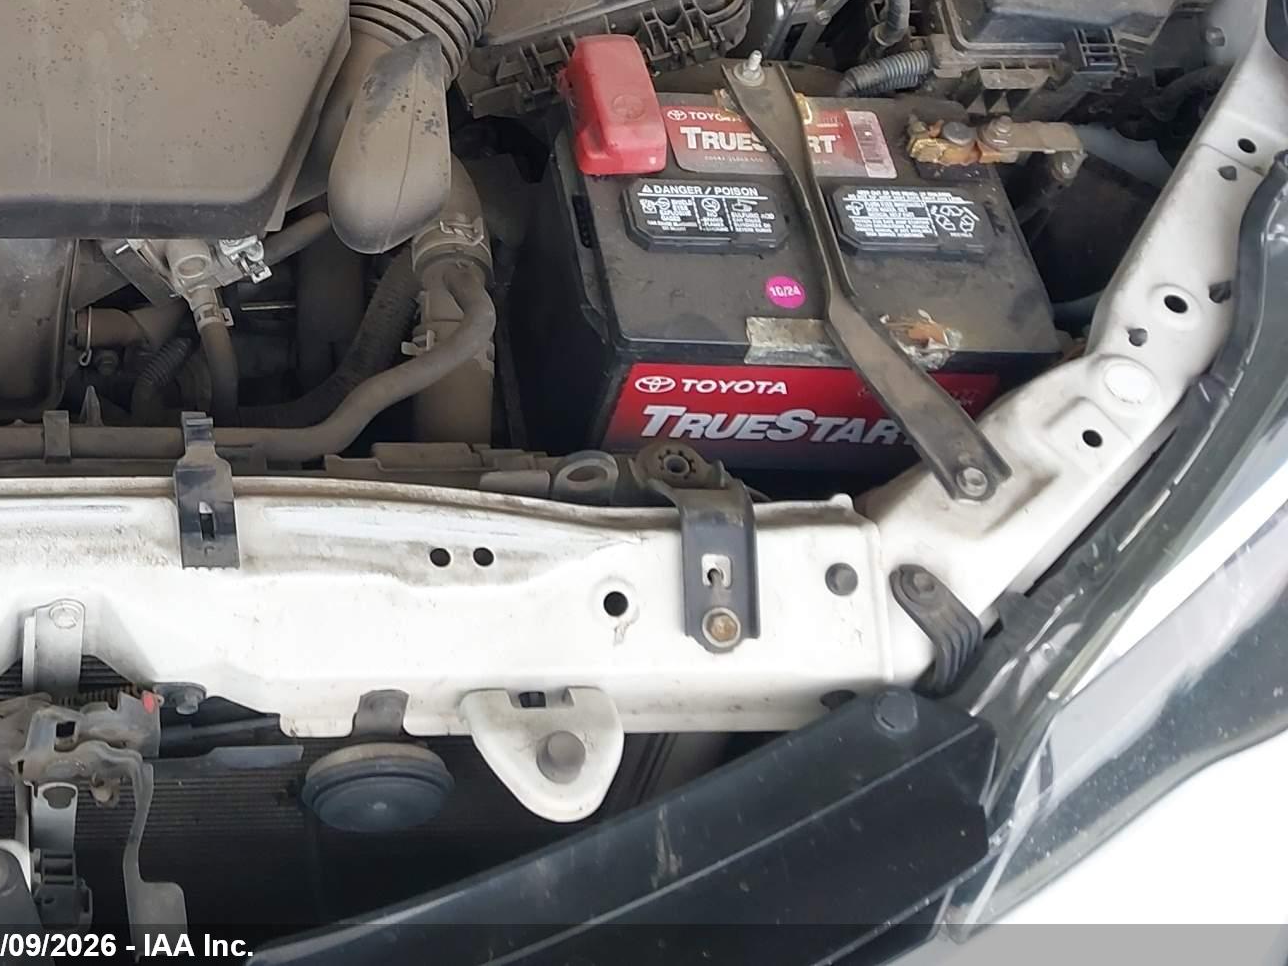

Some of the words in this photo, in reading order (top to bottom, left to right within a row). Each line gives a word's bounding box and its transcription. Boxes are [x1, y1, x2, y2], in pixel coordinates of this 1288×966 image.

[688, 111, 742, 122] TOYO
[680, 126, 836, 154] TRUESRT
[652, 185, 703, 195] DANGER
[714, 186, 758, 196] POISON
[681, 378, 788, 395] TOYOTA
[641, 405, 914, 445] TRUESTAR
